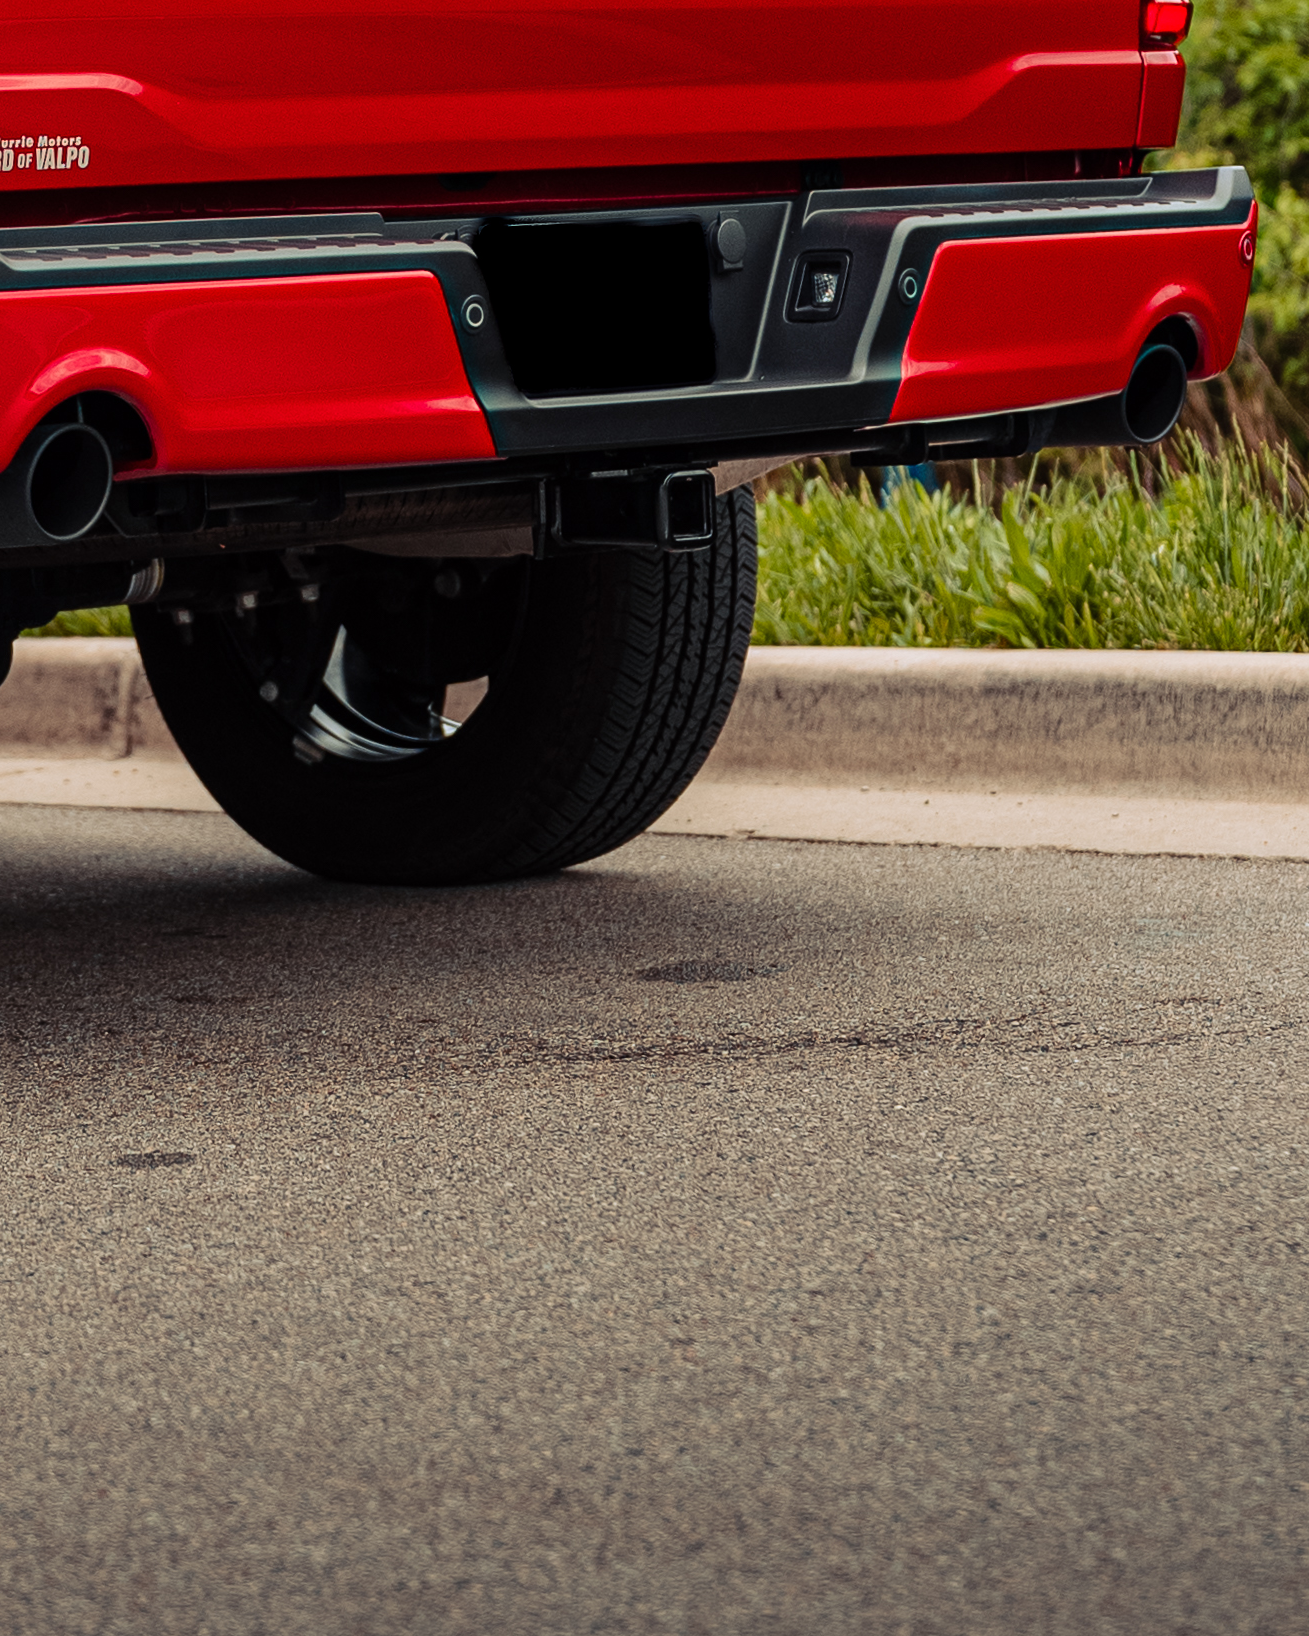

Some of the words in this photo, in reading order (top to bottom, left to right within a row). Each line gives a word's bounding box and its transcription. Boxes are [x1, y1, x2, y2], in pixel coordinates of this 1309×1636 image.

[37, 135, 82, 148] Motors
[17, 152, 33, 169] OF
[35, 145, 90, 171] VALPO
